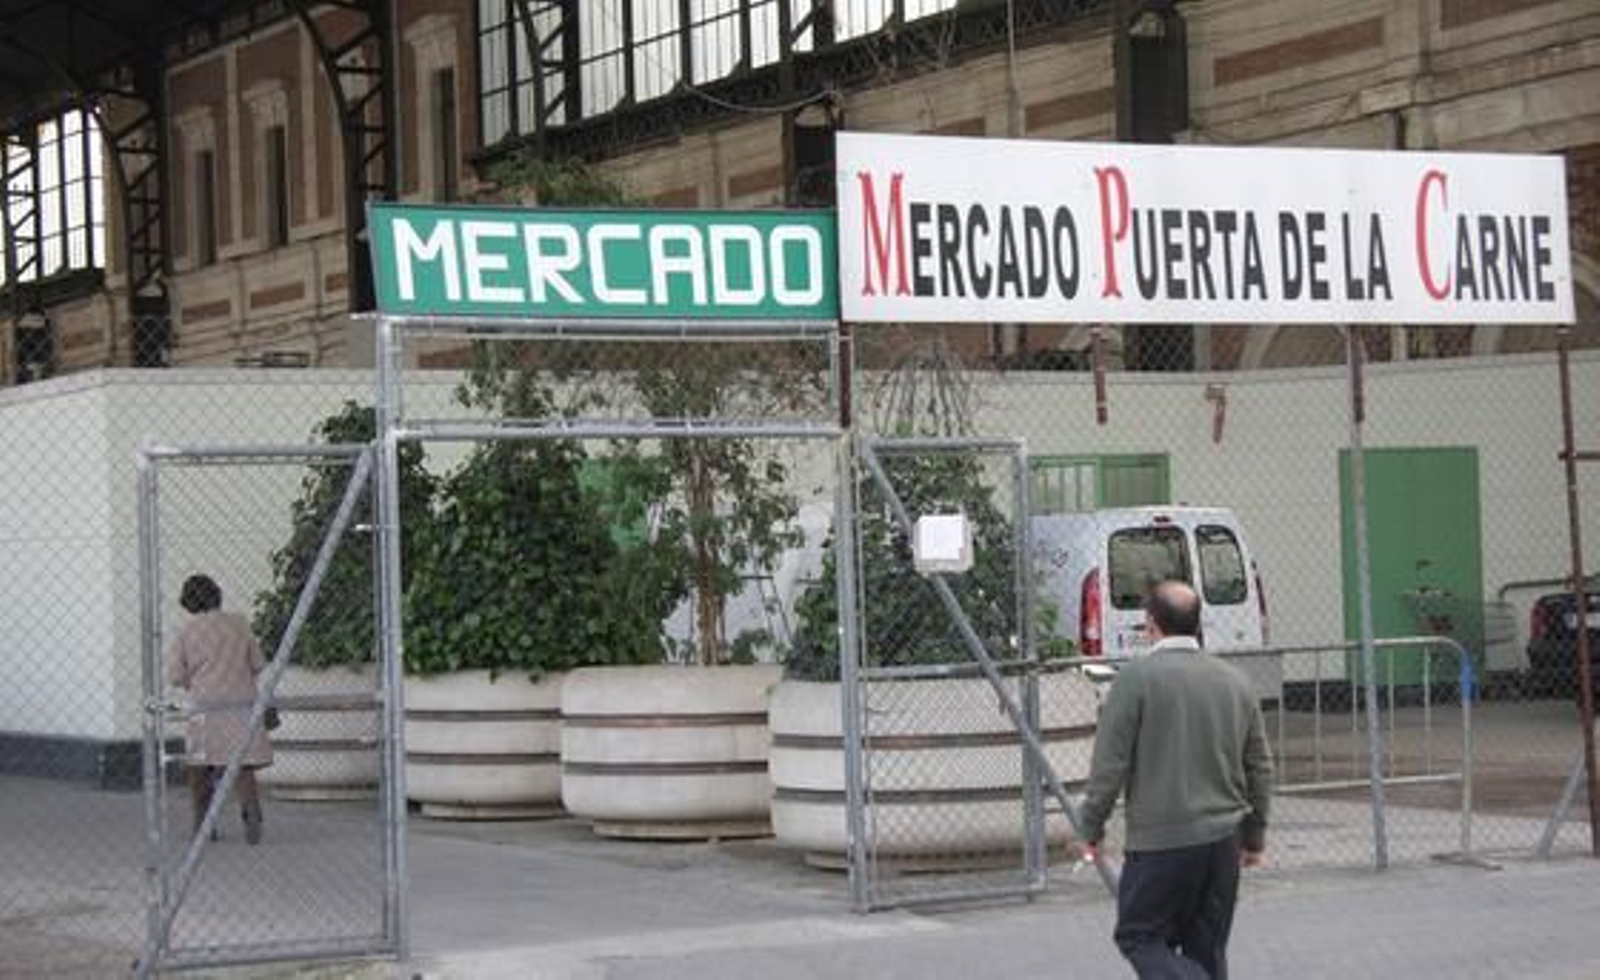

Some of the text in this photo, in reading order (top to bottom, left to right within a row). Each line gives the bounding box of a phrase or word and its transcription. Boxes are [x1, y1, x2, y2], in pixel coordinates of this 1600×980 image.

[392, 218, 823, 306] MERCADO
[858, 165, 1556, 302] MERCADO PUERTA DE LA CARNE
